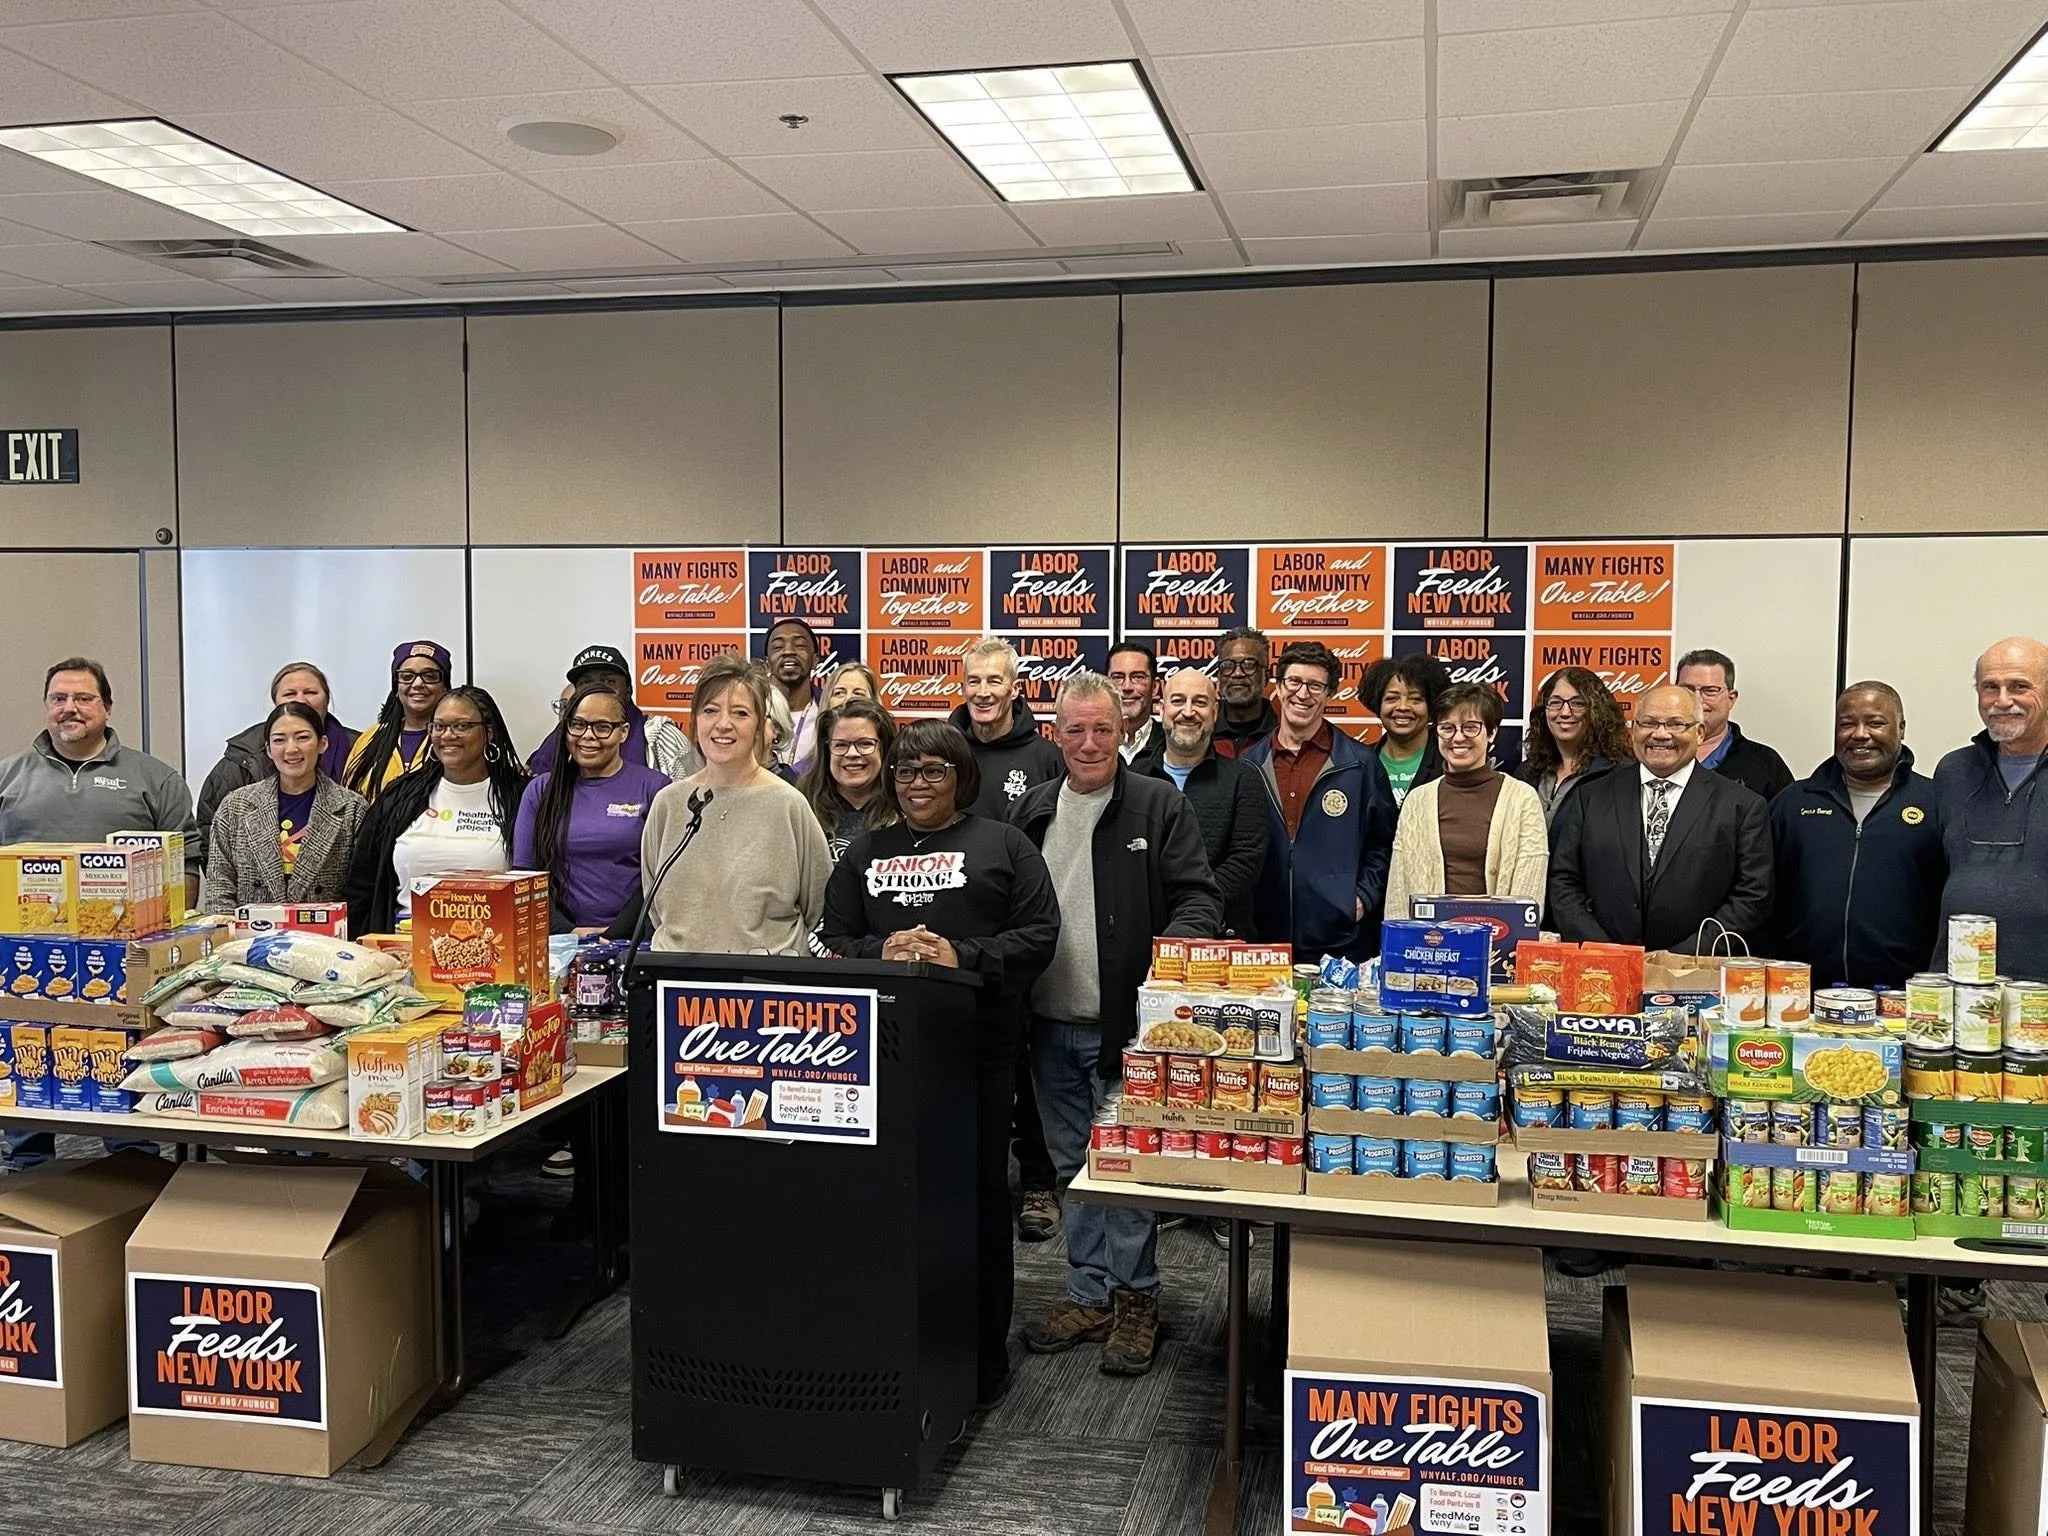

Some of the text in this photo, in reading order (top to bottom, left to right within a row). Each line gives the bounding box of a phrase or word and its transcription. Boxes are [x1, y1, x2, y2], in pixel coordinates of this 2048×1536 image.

[8, 433, 62, 480] EXIT
[777, 554, 831, 574] LABOR
[882, 556, 971, 574] LABOR and
[1021, 553, 1078, 573] LABOR
[1157, 552, 1217, 572] LABOR
[1273, 551, 1373, 571] LABOR and
[1429, 549, 1493, 571] LABOR
[1545, 556, 1664, 576] MANY FIGHTS
[642, 561, 738, 579] MANY FIGHTS
[766, 569, 846, 597] Feeds
[880, 577, 970, 594] COMMUNITY
[1010, 568, 1094, 597] Feeds
[1146, 567, 1232, 597] Feeds
[1271, 574, 1372, 592] COMMUNITY
[1415, 565, 1510, 597] Feeds
[639, 583, 743, 606] One Table!
[1541, 580, 1671, 604] One Table!
[760, 594, 848, 614] NEW YORK
[880, 591, 973, 626] Together
[1003, 593, 1096, 614] NEW YORK
[1138, 593, 1235, 614] NEW YORK
[1270, 588, 1375, 624] Together
[1408, 592, 1512, 613] NEW YORK
[643, 644, 683, 660] MANY
[882, 639, 928, 655] LABOR
[1021, 639, 1078, 658] LABOR
[1156, 639, 1216, 659] LABOR
[1426, 638, 1490, 661] LABOR
[1543, 647, 1662, 666] MANY FIGHTS
[640, 665, 681, 686] One
[880, 659, 964, 675] COMMUNIT
[24, 863, 60, 873] GOYA
[82, 856, 124, 868] GOYA
[876, 854, 956, 873] UNION
[874, 872, 953, 888] STRONG!
[451, 893, 487, 904] Honey Nut
[430, 898, 491, 919] Cheerios
[1524, 906, 1537, 923] 6
[1191, 948, 1229, 962] HELP
[1232, 952, 1289, 965] HELPER
[1405, 949, 1460, 963] CHICKEN BREAST
[678, 996, 857, 1036] MANY FIGHTS
[1223, 1006, 1253, 1017] GOYA
[1317, 1022, 1346, 1031] PROGRESSO
[1363, 1026, 1392, 1034] PROGRESSO
[1412, 1028, 1441, 1036] PROGRESSO
[1454, 1030, 1482, 1038] PROGRESSO
[1561, 1016, 1636, 1035] GOYA
[679, 1021, 858, 1067] One Table
[1573, 1035, 1625, 1050] Black Beans
[1567, 1046, 1631, 1061] Frijoles Negros
[1740, 1048, 1783, 1059] Del Monte
[1885, 1046, 1899, 1057] 12
[353, 1052, 404, 1078] Stuffing
[1126, 1067, 1157, 1080] Hunt's
[198, 1068, 233, 1089] Canilla
[368, 1074, 388, 1082] mix
[771, 1068, 858, 1082] WNYALF.ORG/HUNGER
[1170, 1069, 1200, 1083] Hunt's
[1216, 1072, 1247, 1086] Hunt's
[1530, 1072, 1552, 1081] GOYA
[1268, 1079, 1299, 1091] Hunt's
[1322, 1084, 1350, 1093] PROGRESSO
[1365, 1087, 1394, 1095] PROGRESSO
[1412, 1089, 1441, 1098] PROGRESSO
[156, 1091, 193, 1111] Canilla
[1455, 1091, 1483, 1099] PROGRESSO
[206, 1104, 265, 1116] Enriched Rice
[1670, 1105, 1699, 1113] PROGRESSO
[1365, 1149, 1393, 1157] PROGRESSO
[1416, 1151, 1444, 1160] PROGRESSO
[1454, 1154, 1483, 1162] PROGRESSO
[1537, 1158, 1561, 1167] Moore
[1634, 1159, 1654, 1168] Dinty
[183, 1286, 273, 1325] LABOR
[167, 1317, 297, 1362] Feeds
[158, 1351, 303, 1394] NEW YORK
[185, 1394, 275, 1411] WNYALF.ORG/HUNGER
[1309, 1388, 1523, 1435] MANY FIGHTS
[1310, 1417, 1524, 1469] One Table
[1710, 1416, 1838, 1464] LABOR
[1310, 1464, 1326, 1473] Food
[1328, 1464, 1347, 1474] Drive
[1420, 1470, 1525, 1486] WNYALF.ORG/HUNGER
[1686, 1451, 1874, 1510] Feeds
[1430, 1510, 1481, 1522] FeedMore
[1672, 1494, 1880, 1536] NEW YORK
[1430, 1520, 1452, 1529] wny
